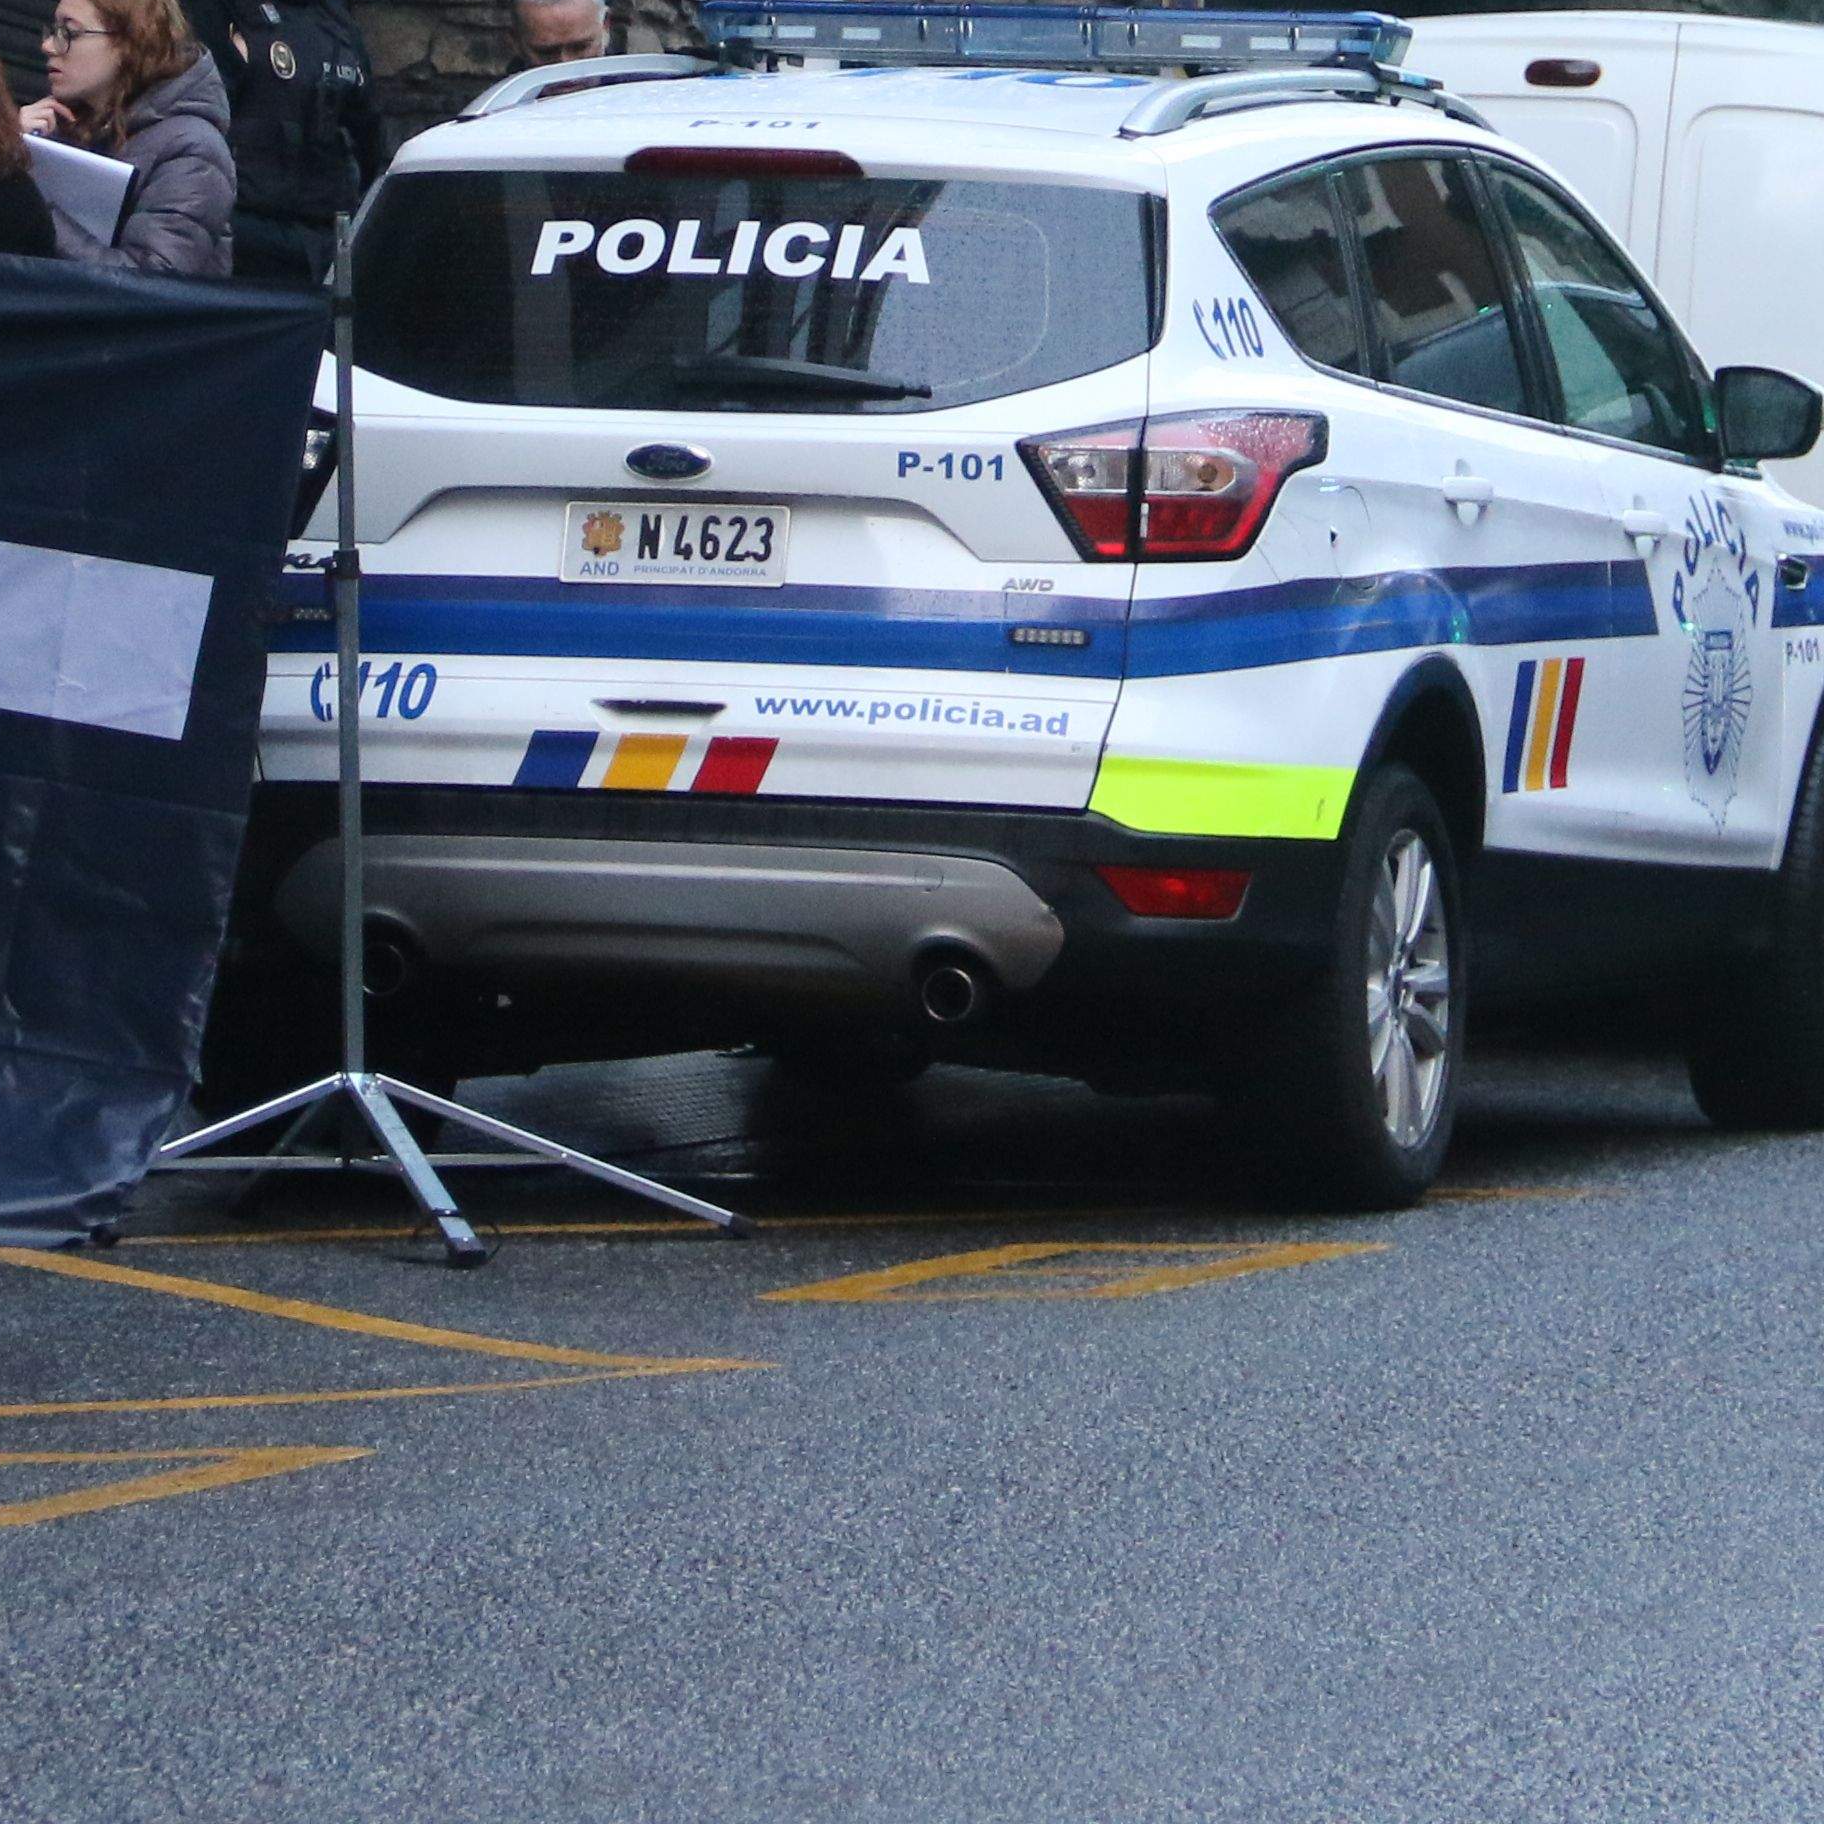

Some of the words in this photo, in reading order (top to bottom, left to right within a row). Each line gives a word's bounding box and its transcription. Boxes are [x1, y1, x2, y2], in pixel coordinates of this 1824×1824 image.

[688, 118, 823, 130] P-101
[530, 218, 931, 285] POLICIA
[1212, 297, 1265, 358] 110
[897, 451, 1004, 481] P-101
[580, 561, 619, 576] AND
[633, 564, 694, 575] PRINCIPAT
[1002, 578, 1055, 591] AWD
[754, 696, 1070, 736] www.policia.ad
